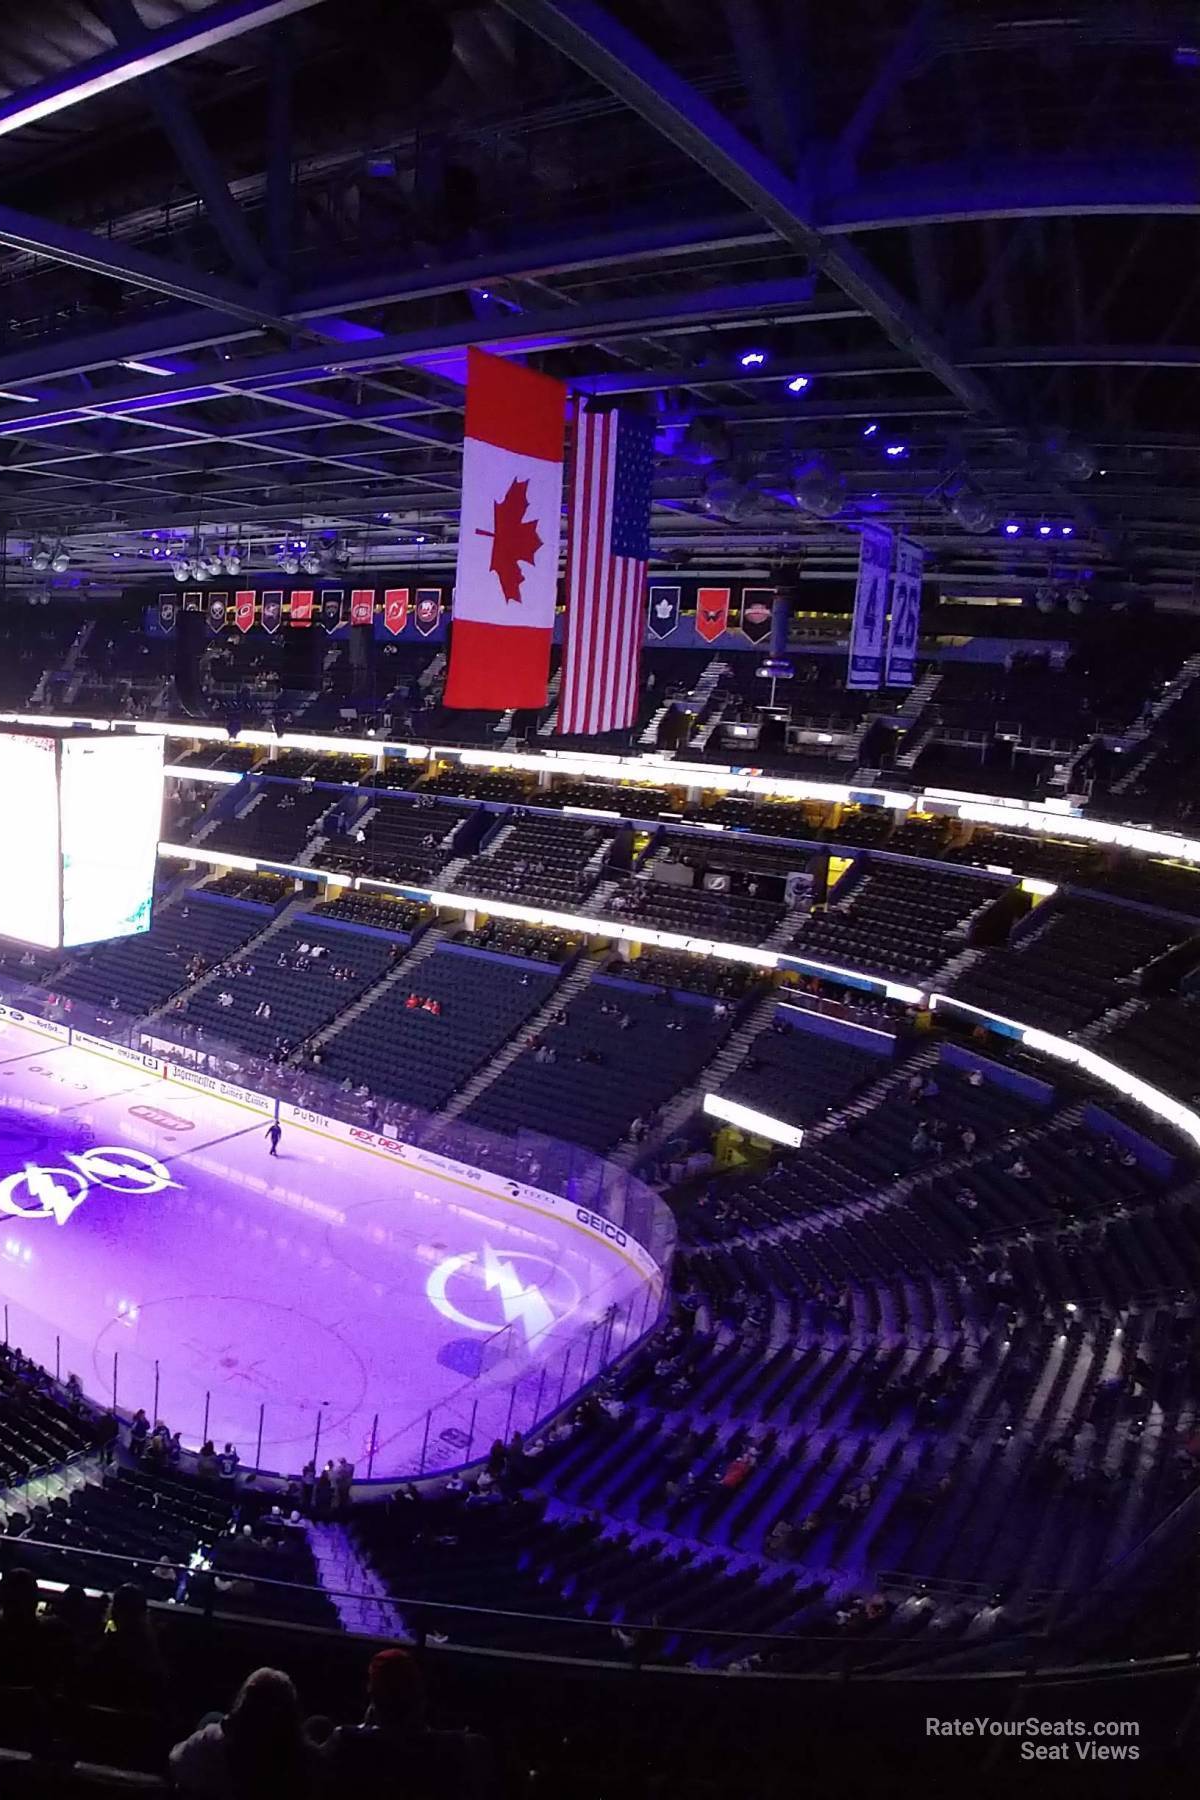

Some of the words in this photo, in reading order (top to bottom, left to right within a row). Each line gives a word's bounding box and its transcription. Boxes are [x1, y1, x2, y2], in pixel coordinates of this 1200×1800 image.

[293, 1107, 329, 1128] Publix
[349, 1128, 374, 1142] DEX
[378, 1138, 404, 1153] DEX
[576, 1208, 627, 1248] GEICO
